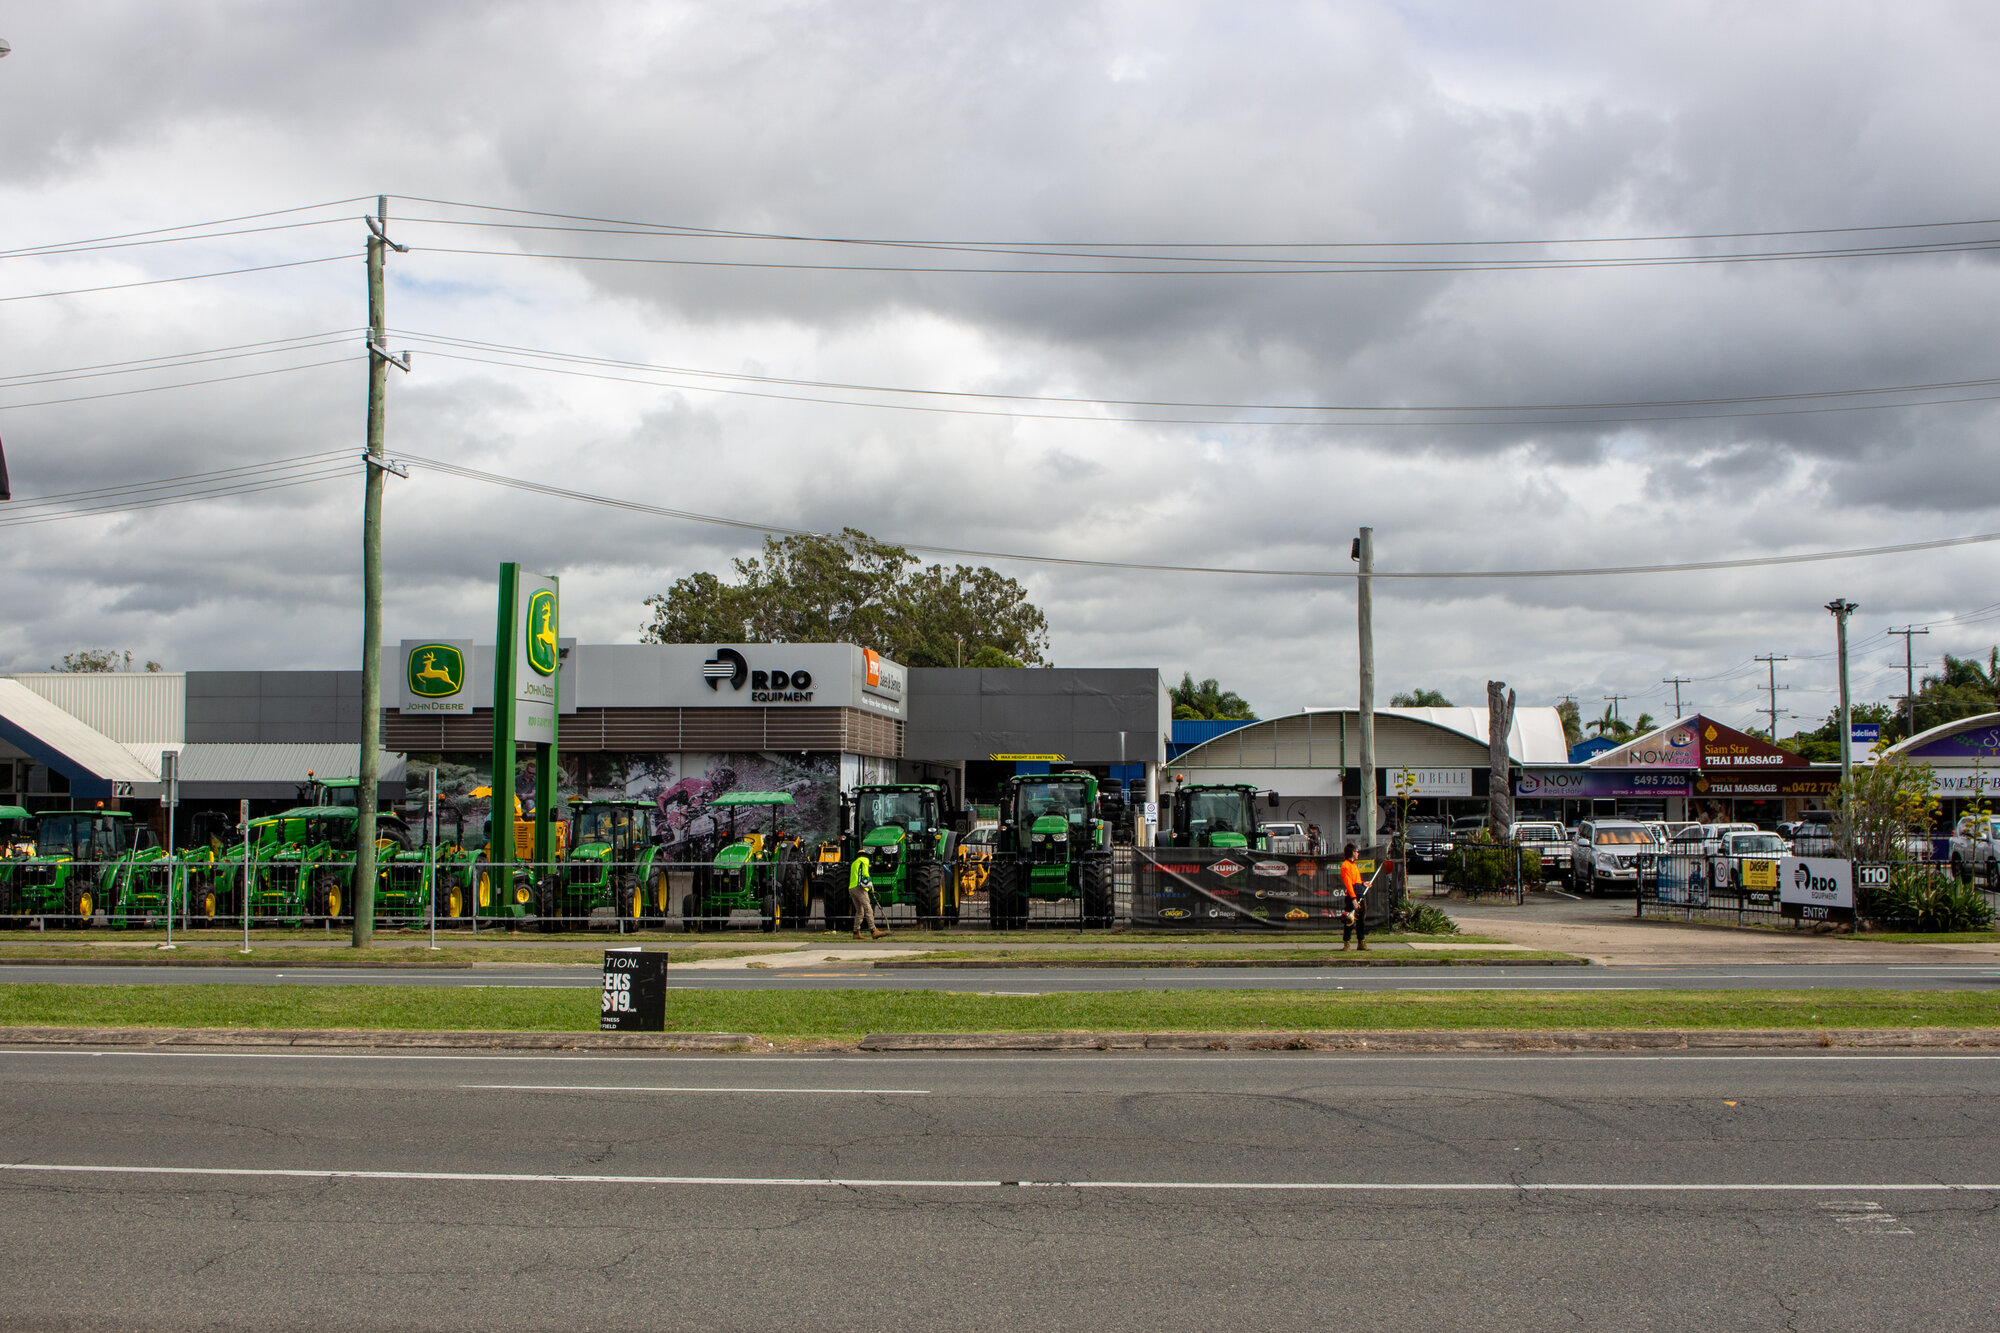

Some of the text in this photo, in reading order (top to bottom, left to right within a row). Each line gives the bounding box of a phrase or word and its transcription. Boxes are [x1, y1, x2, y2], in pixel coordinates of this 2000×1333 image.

[752, 670, 812, 690] RDO
[524, 682, 541, 695] JOHN
[752, 692, 813, 702] EQUIPMENT
[406, 702, 465, 711] JOHN DEERE
[1705, 745, 1749, 754] Siam Star
[1629, 751, 1674, 764] NOW
[1706, 755, 1783, 765] THAI MASSAGE
[1429, 772, 1467, 784] BELLE
[1544, 775, 1583, 787] NOW
[1634, 776, 1686, 785] 5495 7303
[1710, 784, 1732, 792] THAI
[1734, 784, 1778, 792] MASSAGE
[1792, 782, 1817, 792] 0472
[1153, 864, 1200, 874] MANITOU
[1750, 861, 1769, 872] DIGGA
[1862, 868, 1886, 883] 110
[1811, 877, 1838, 892] RDO
[1811, 892, 1838, 901] EQUIPMENT
[1803, 906, 1829, 919] ENTRY
[602, 990, 631, 1012] $19
